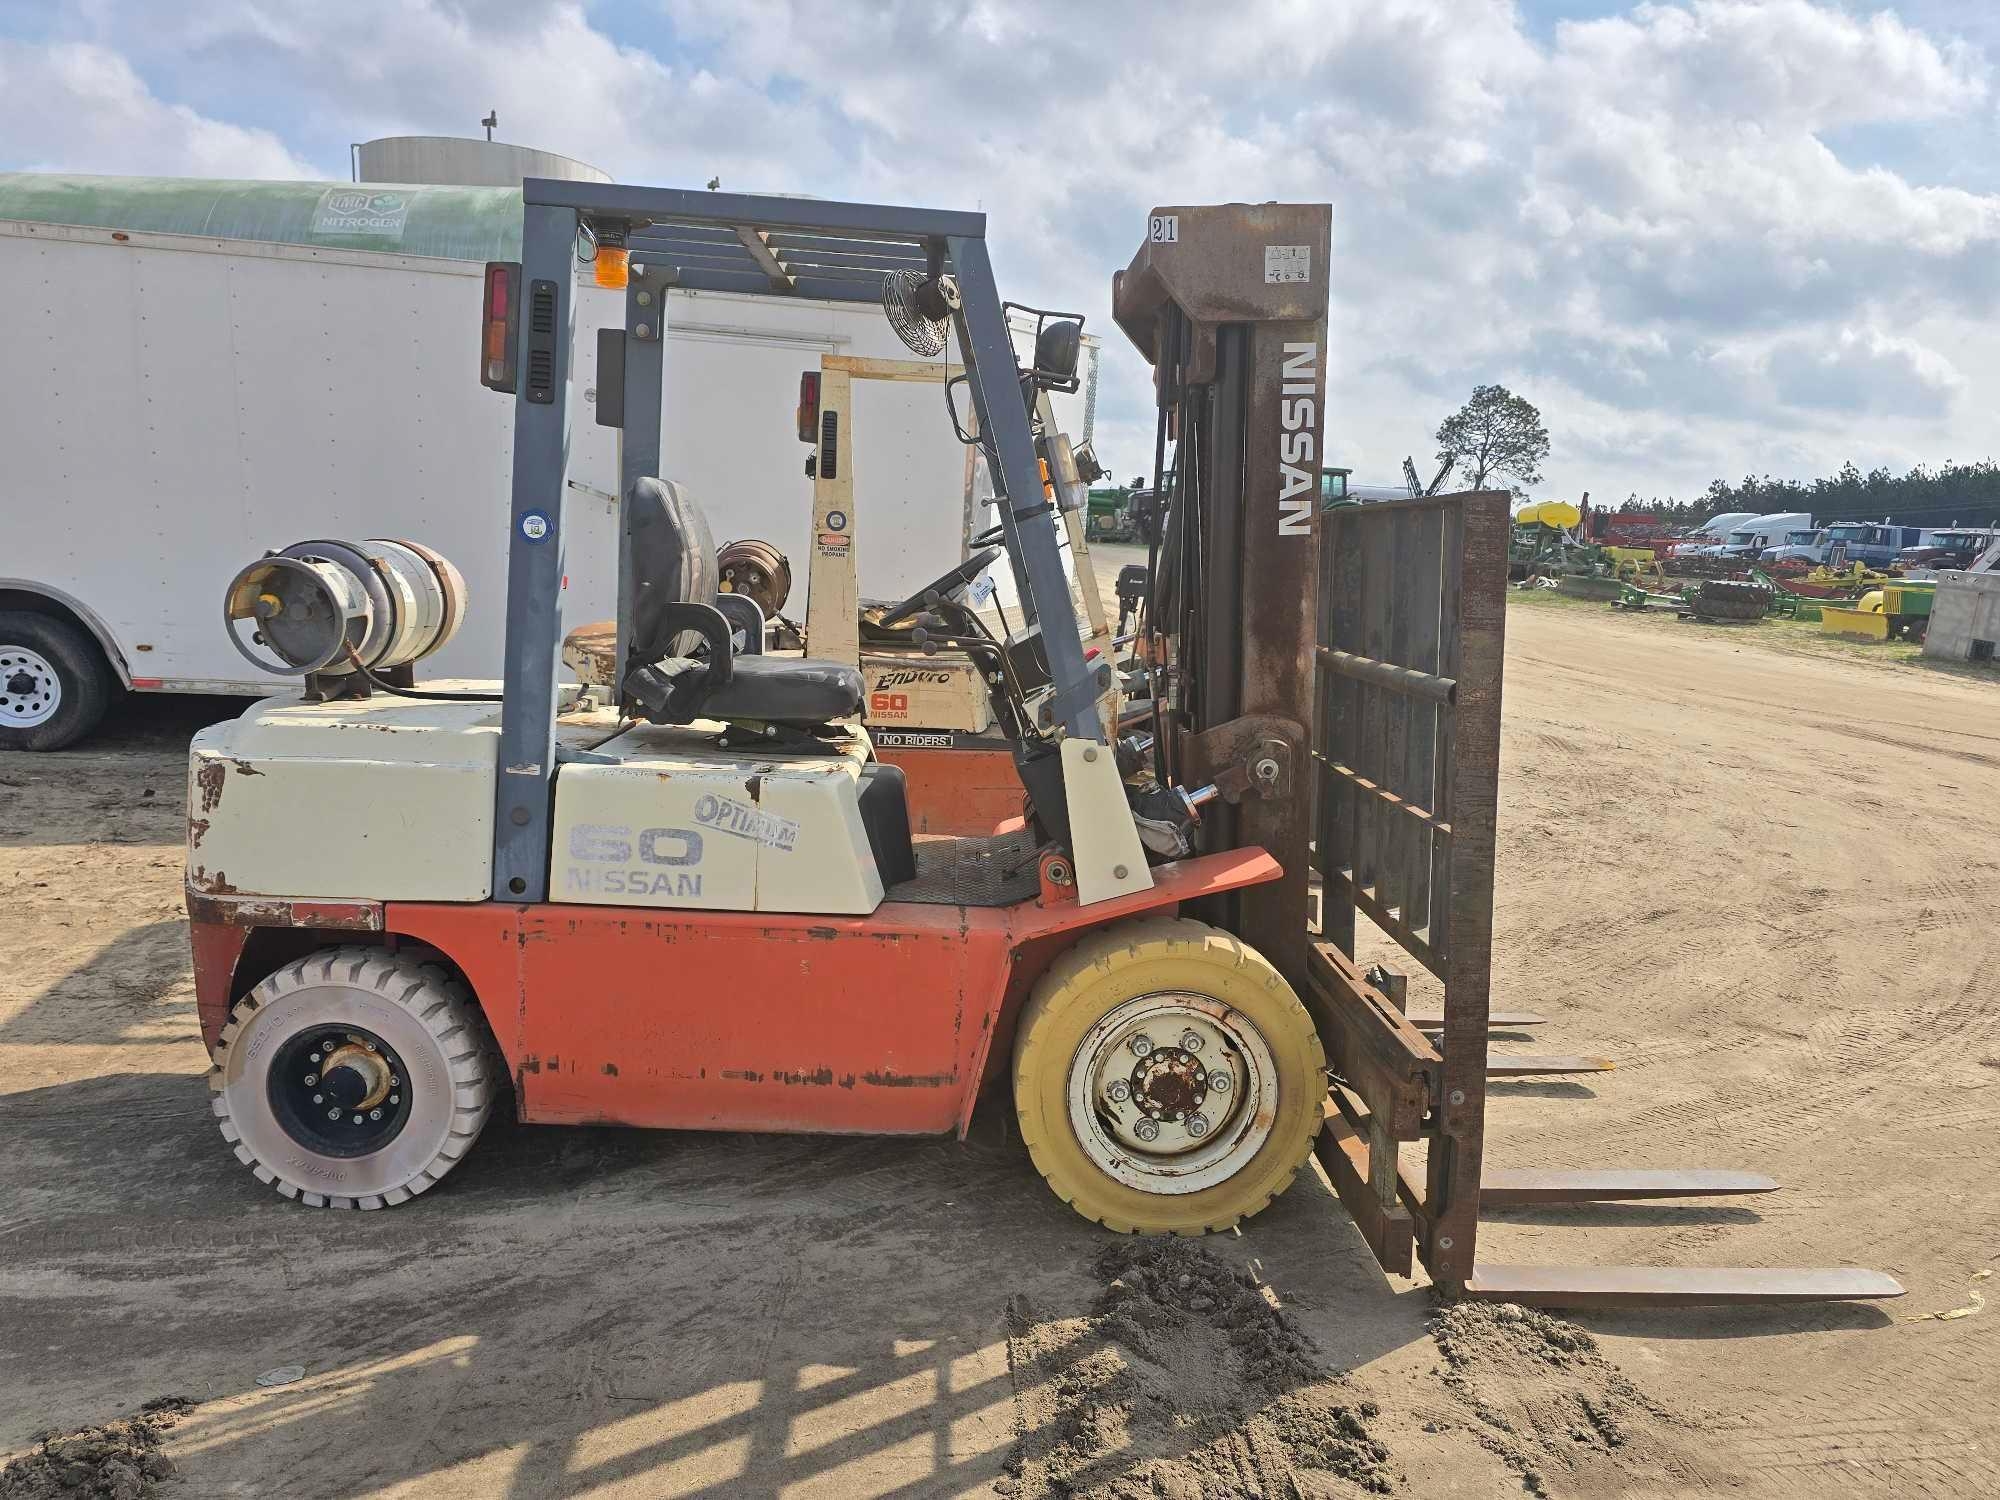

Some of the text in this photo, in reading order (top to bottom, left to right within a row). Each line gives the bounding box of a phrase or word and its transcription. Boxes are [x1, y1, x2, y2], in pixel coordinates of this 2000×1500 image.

[321, 217, 403, 228] NITROGEN
[1152, 218, 1176, 241] 21
[1278, 342, 1317, 536] NISSAN
[871, 694, 908, 711] 60
[870, 711, 908, 719] NISSAN
[883, 735, 947, 746] NO RIDERS
[568, 823, 704, 867] 60
